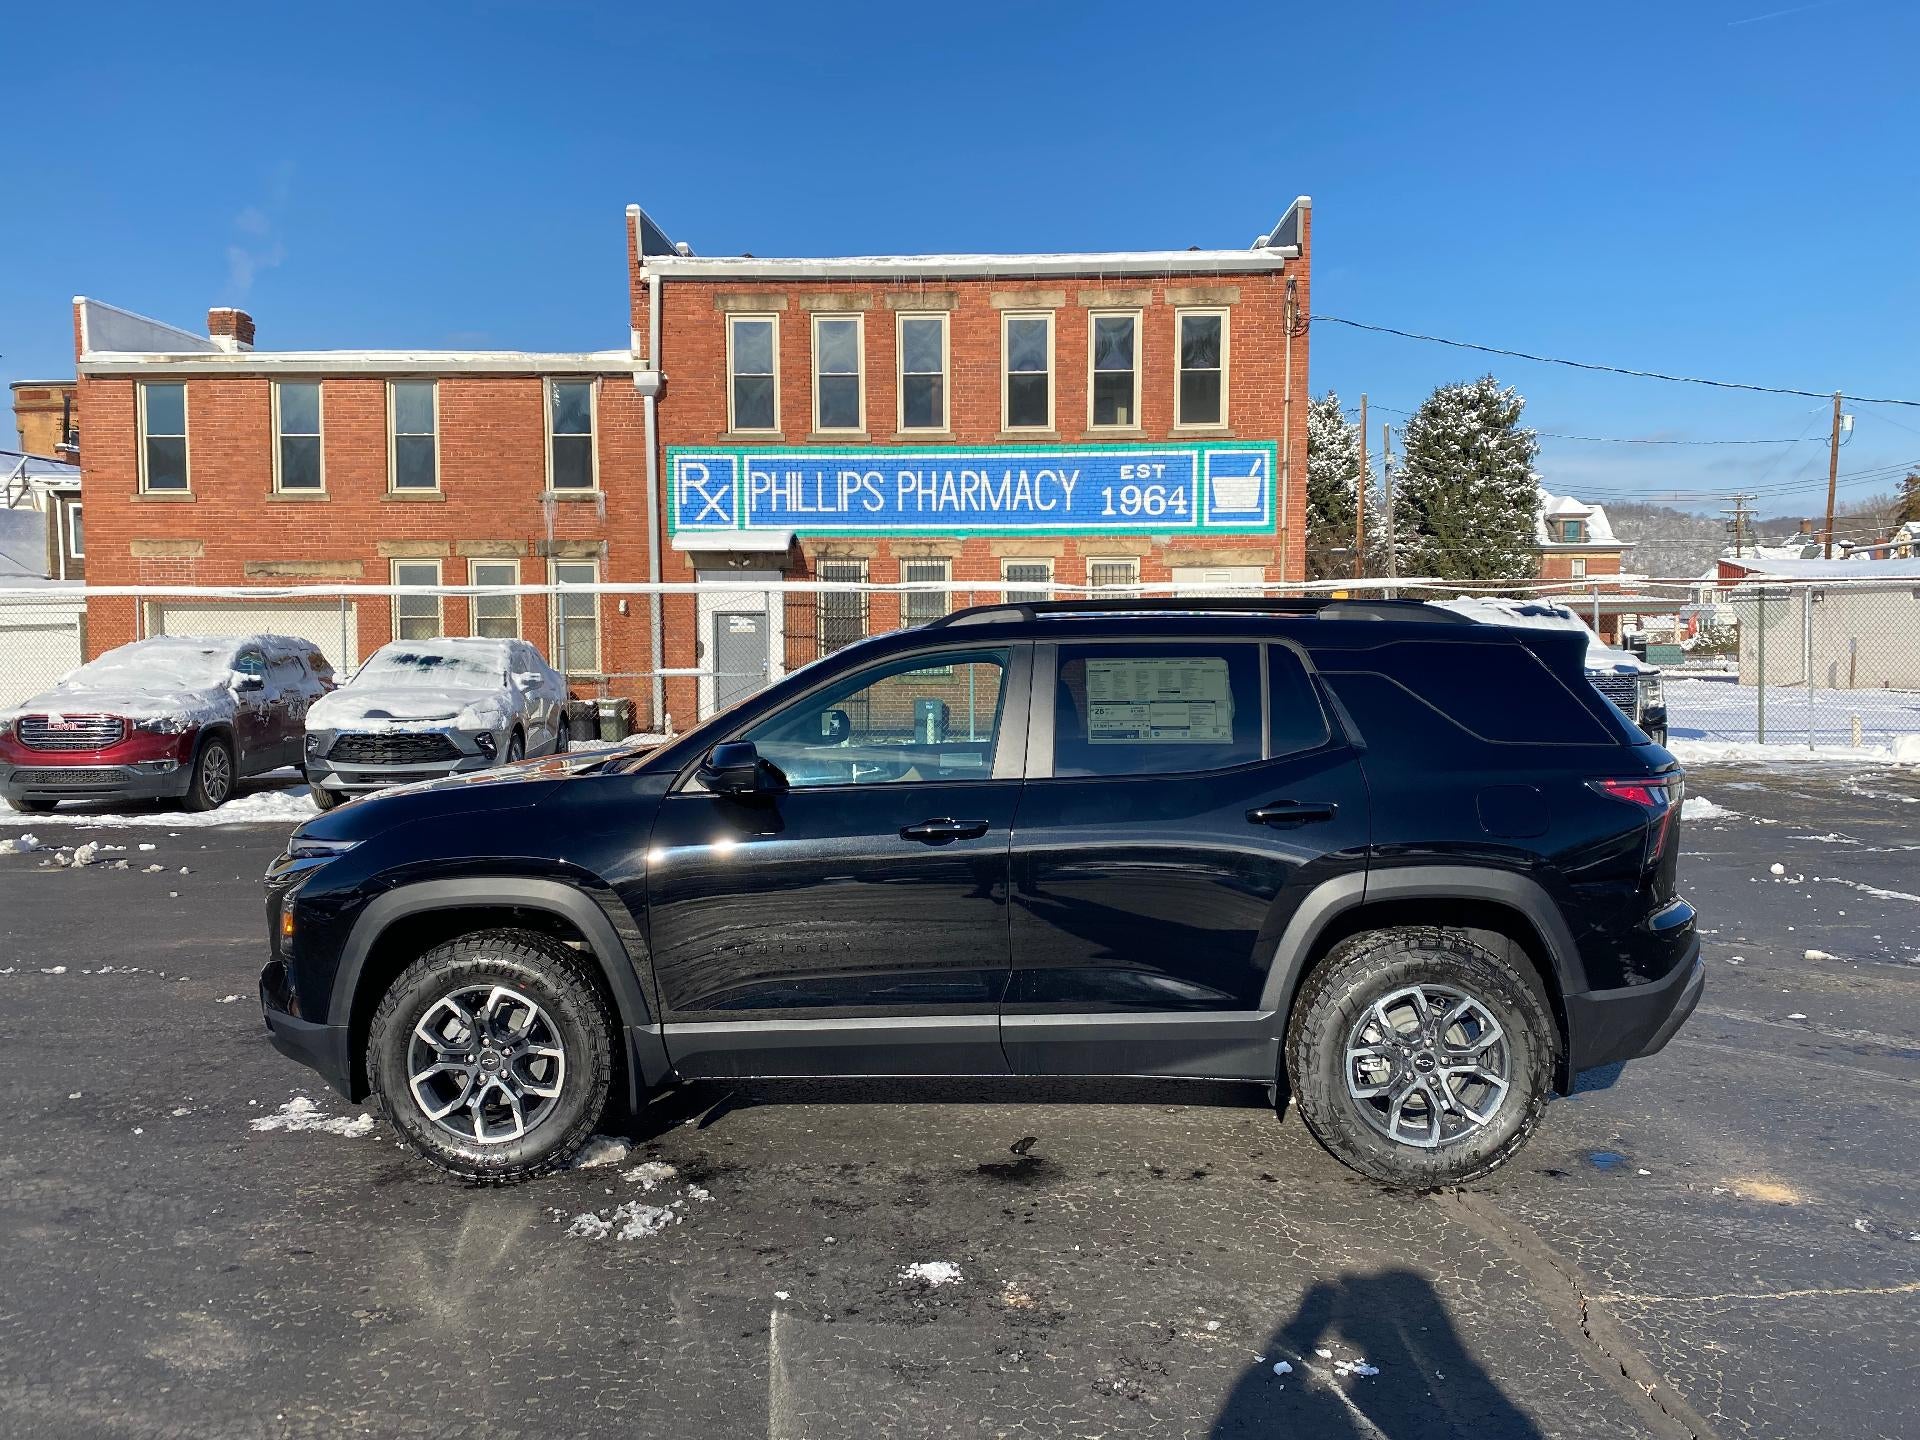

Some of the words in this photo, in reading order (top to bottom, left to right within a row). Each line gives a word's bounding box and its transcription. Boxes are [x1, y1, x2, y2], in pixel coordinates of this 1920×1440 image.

[1119, 464, 1166, 480] EST
[751, 471, 885, 512] PHILLIPS
[898, 469, 1080, 512] PHARMACY
[1101, 485, 1188, 516] 1964
[48, 721, 86, 731] GMC
